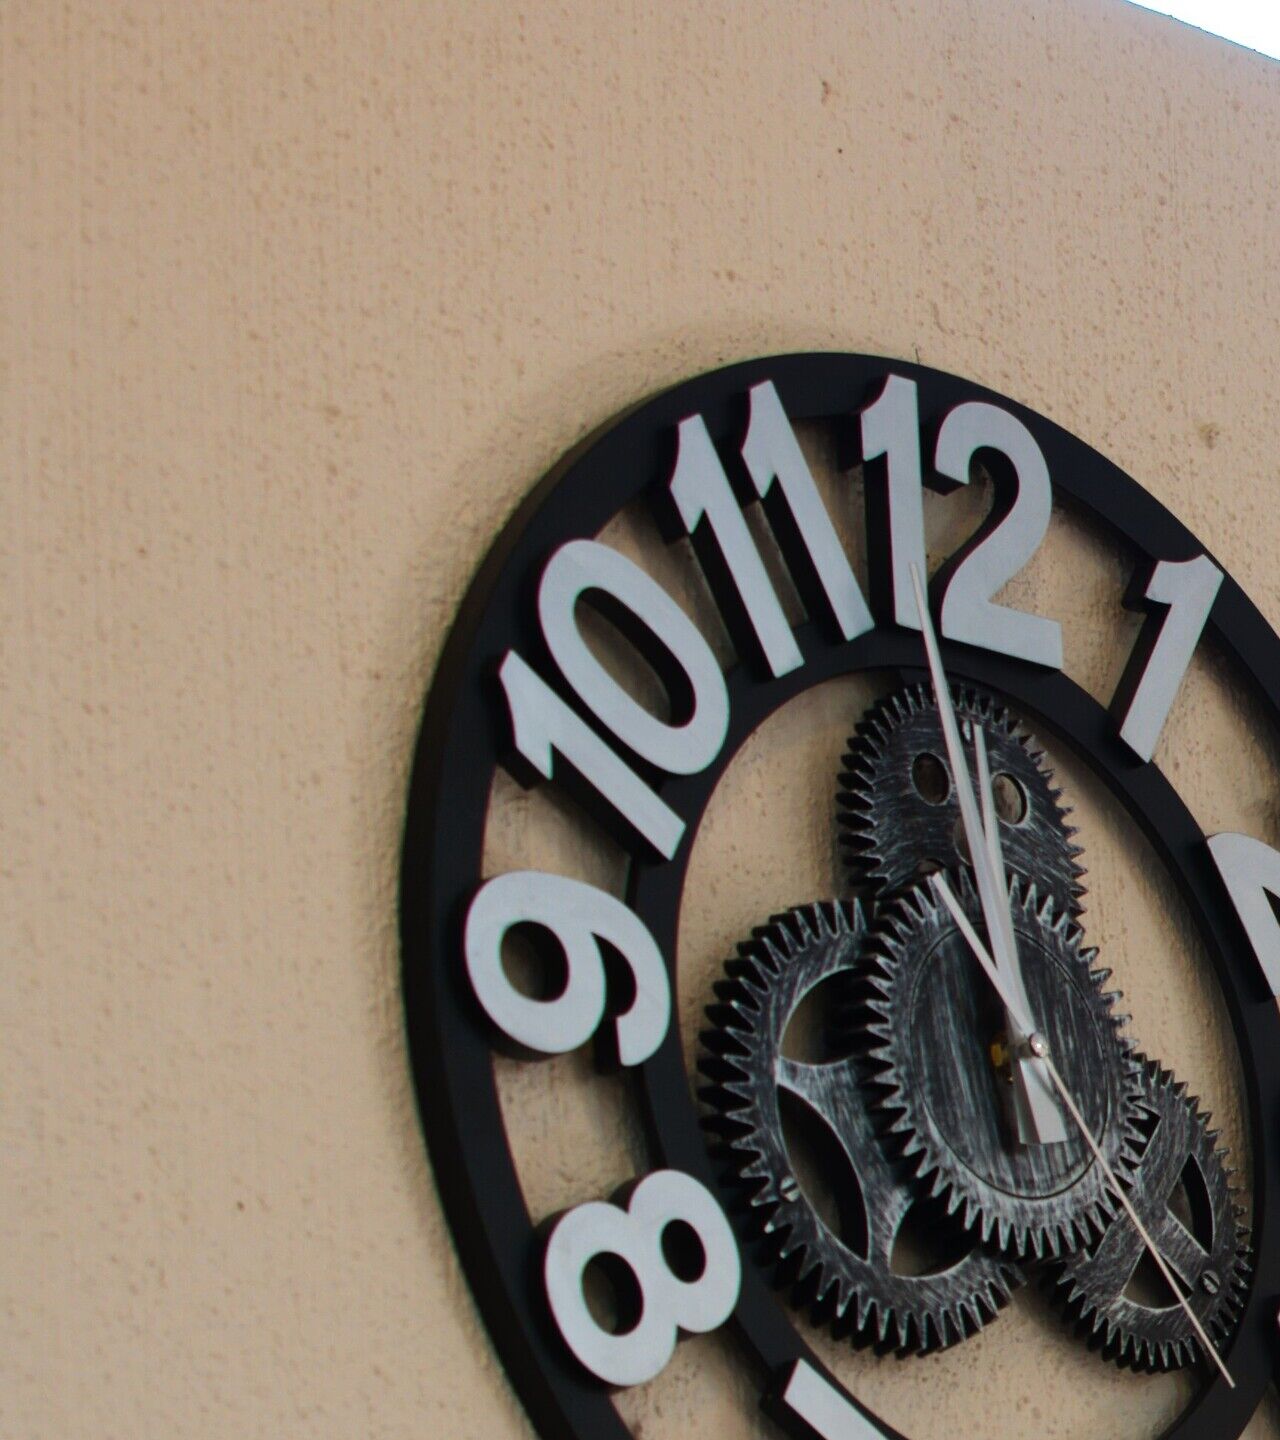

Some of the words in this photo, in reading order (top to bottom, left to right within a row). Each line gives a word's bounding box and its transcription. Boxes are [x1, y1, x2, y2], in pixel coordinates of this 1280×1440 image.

[670, 380, 874, 678] 11
[860, 374, 1062, 671] 12
[498, 539, 729, 859] 10
[1119, 553, 1223, 763] 1
[464, 870, 671, 1067] 9
[544, 1168, 741, 1385] 8
